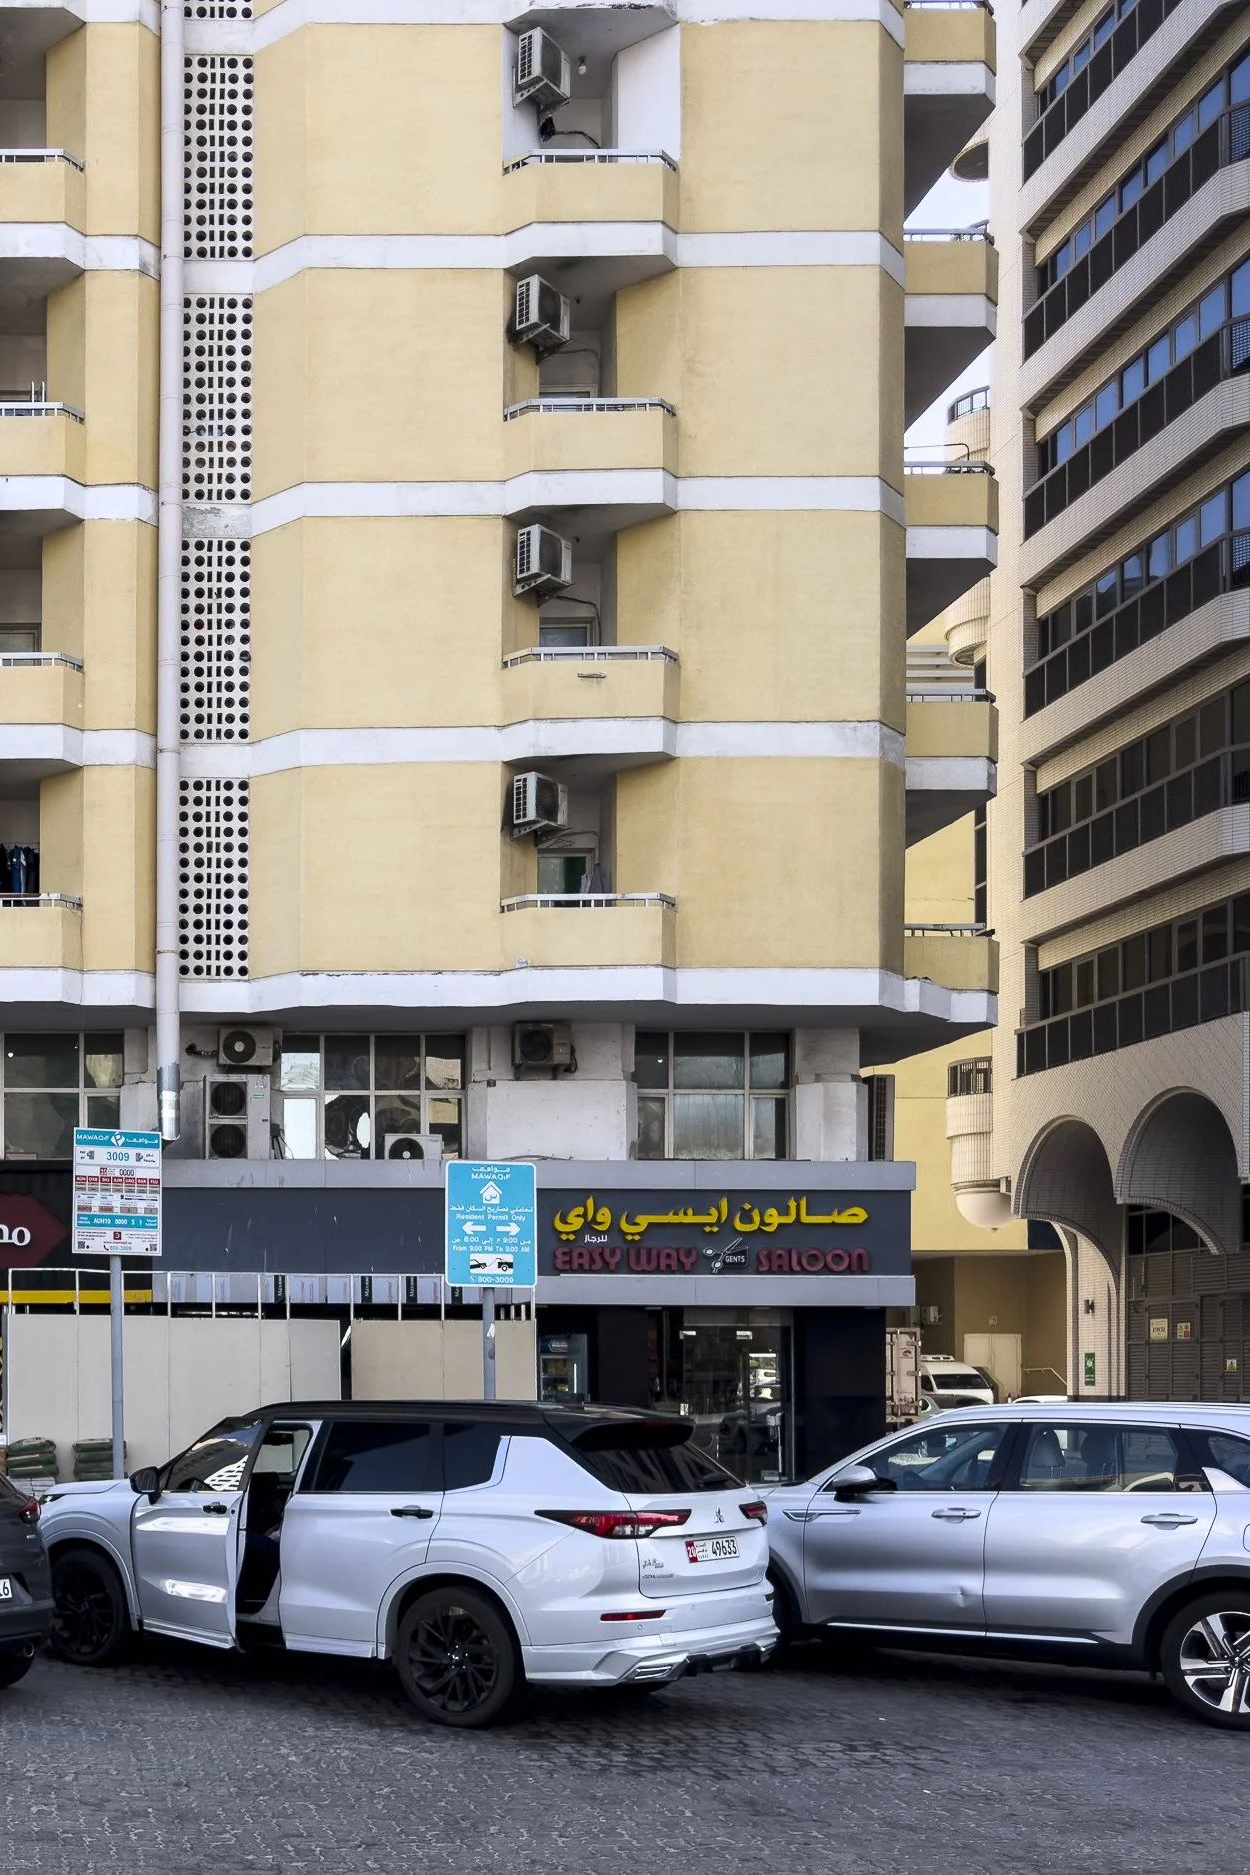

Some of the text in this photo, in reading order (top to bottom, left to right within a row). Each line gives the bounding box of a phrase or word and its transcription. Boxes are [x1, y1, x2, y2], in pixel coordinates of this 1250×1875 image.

[106, 1151, 130, 1162] 3009
[511, 1214, 526, 1222] Only
[553, 1195, 869, 1241] صالون ايسي واي
[554, 1246, 699, 1272] EASY WAY
[724, 1255, 746, 1264] GENTS
[757, 1247, 870, 1273] SALOON
[711, 1539, 737, 1557] 49633
